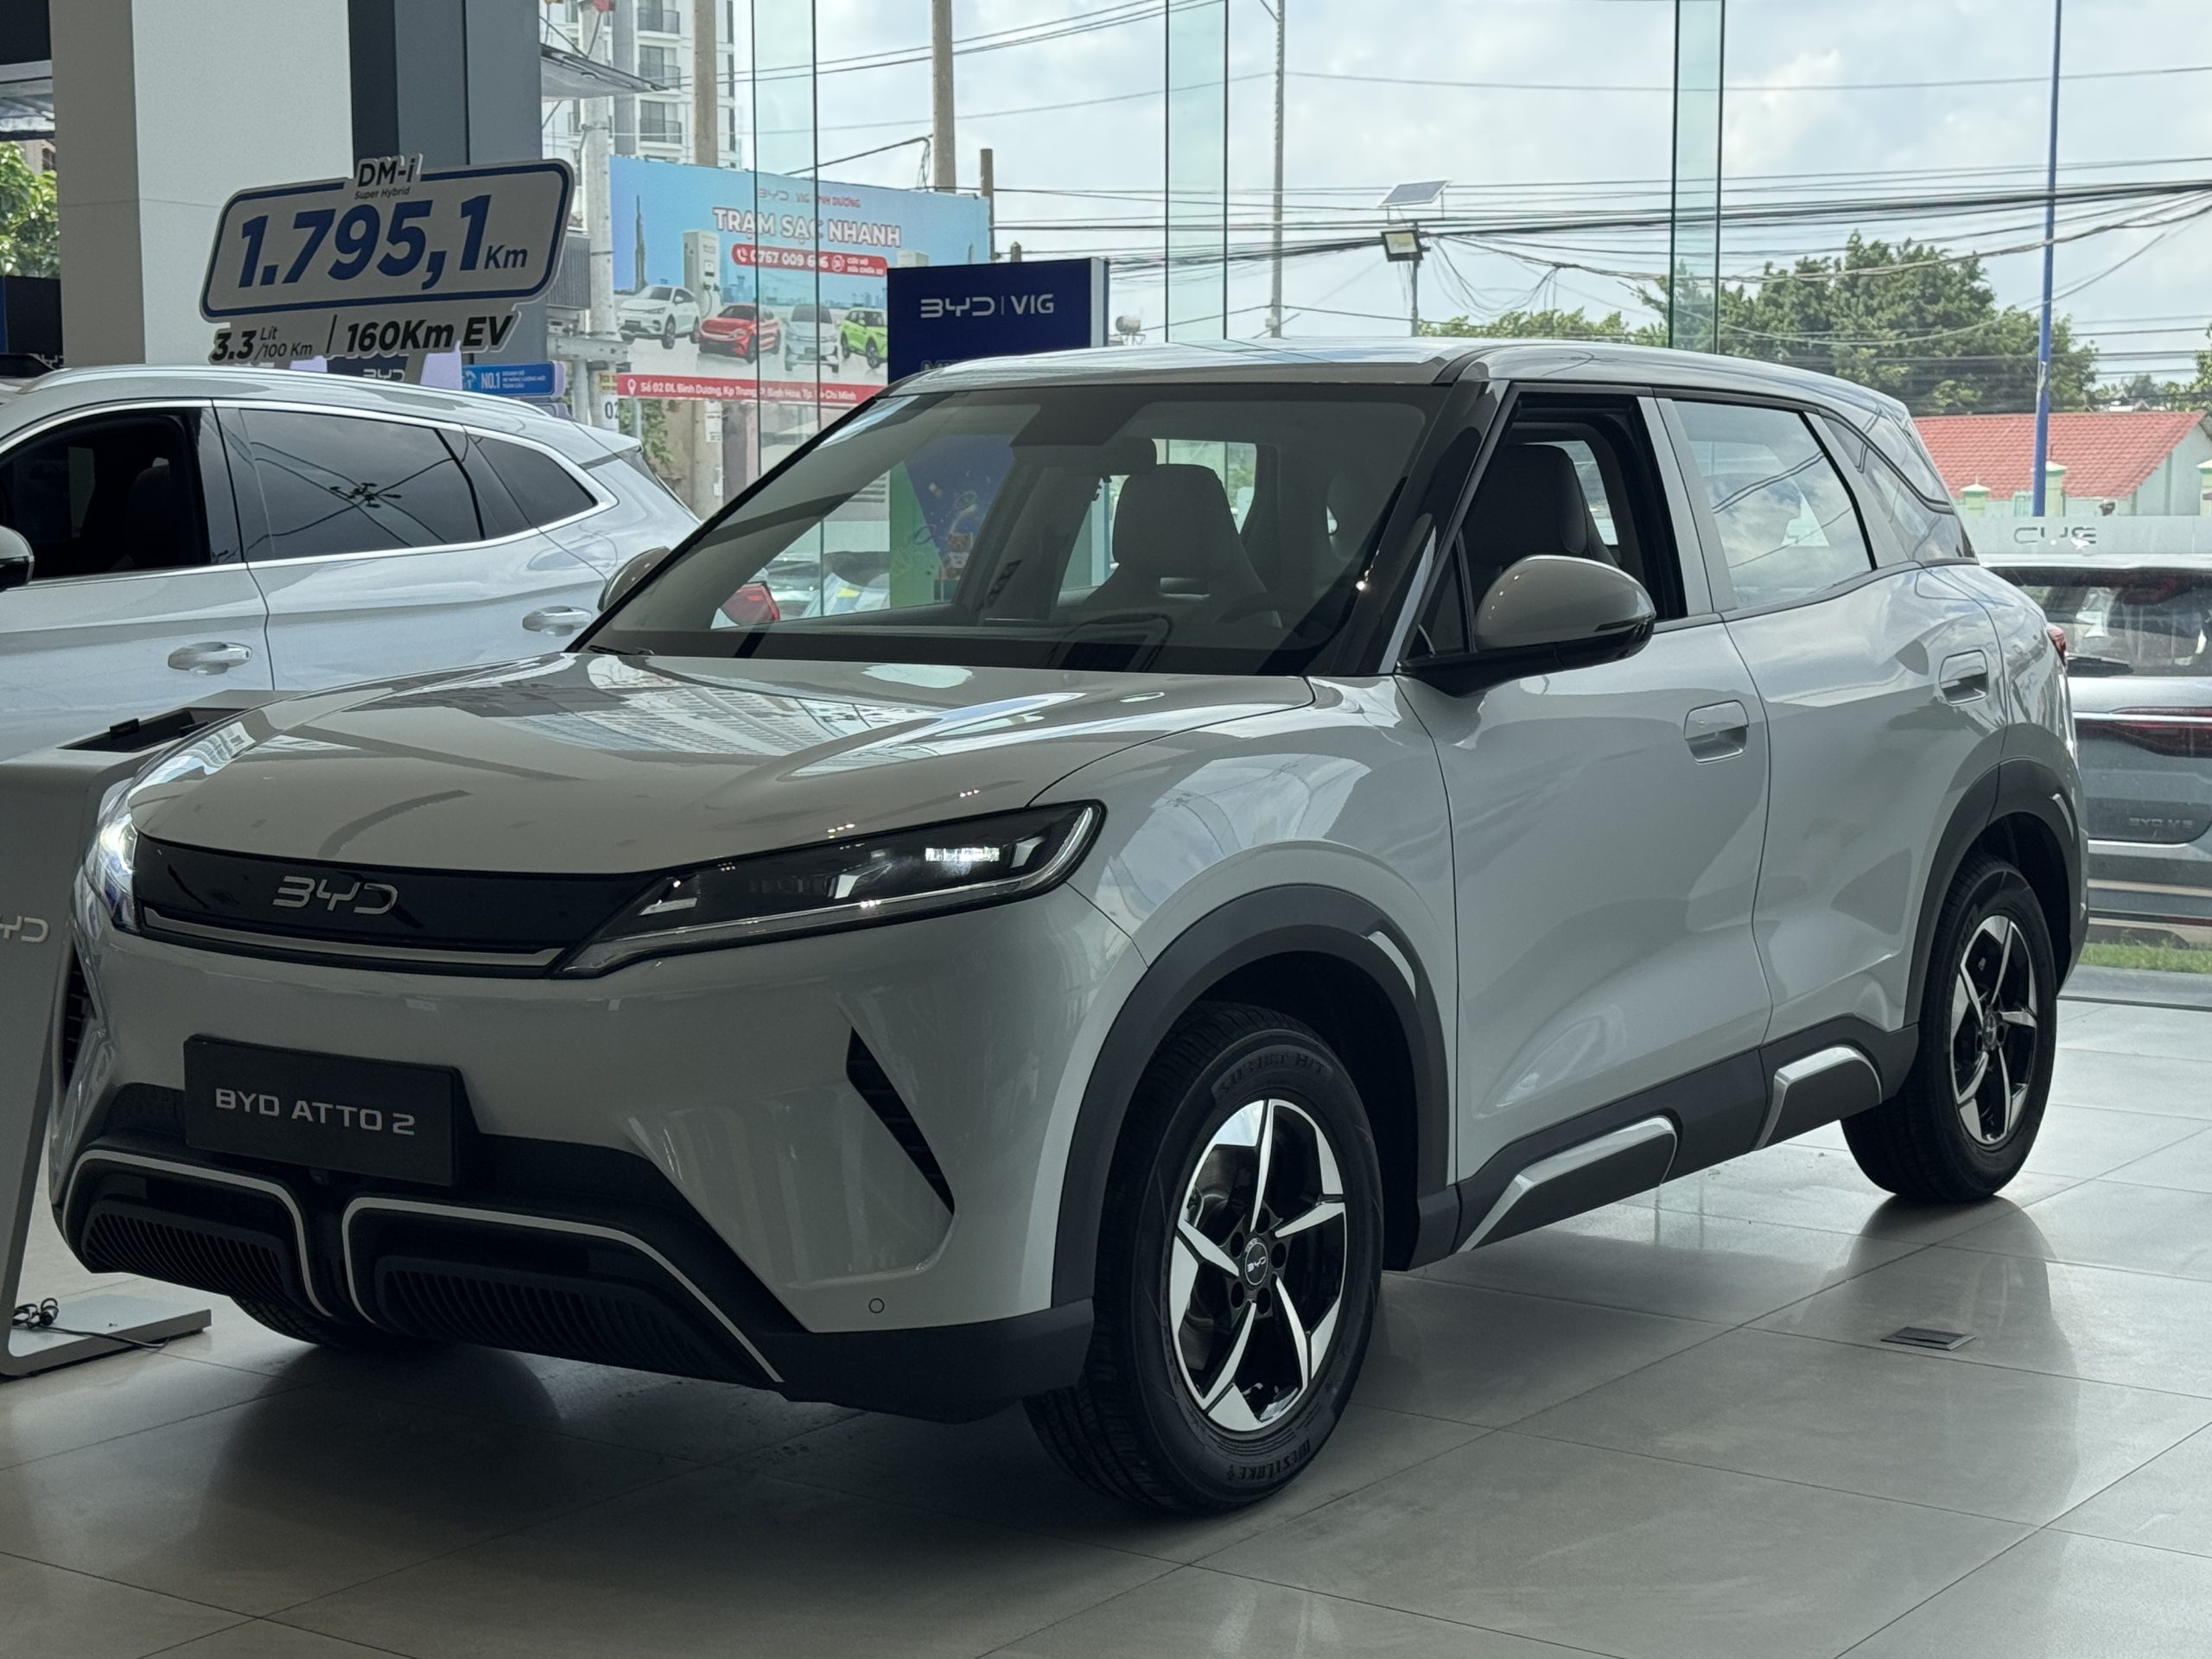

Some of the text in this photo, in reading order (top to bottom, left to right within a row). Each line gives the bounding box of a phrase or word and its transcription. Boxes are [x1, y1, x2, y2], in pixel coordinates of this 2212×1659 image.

[358, 158, 416, 188] DM-i
[354, 187, 410, 200] Super Hybrid
[713, 207, 775, 239] TRẠM
[829, 219, 901, 248] NHANH
[238, 194, 528, 291] 1.795,1 Km
[806, 254, 829, 269] 66
[920, 294, 1055, 318] BYD VIG
[212, 330, 257, 361] 3.3
[347, 315, 514, 353] 160Km EV
[254, 342, 313, 360] /100 Km
[480, 372, 500, 390] NO.1
[272, 875, 398, 915] BYD
[0, 916, 49, 943] YD
[216, 1088, 416, 1135] BYD ATTO 2
[1247, 1256, 1267, 1272] BYD
